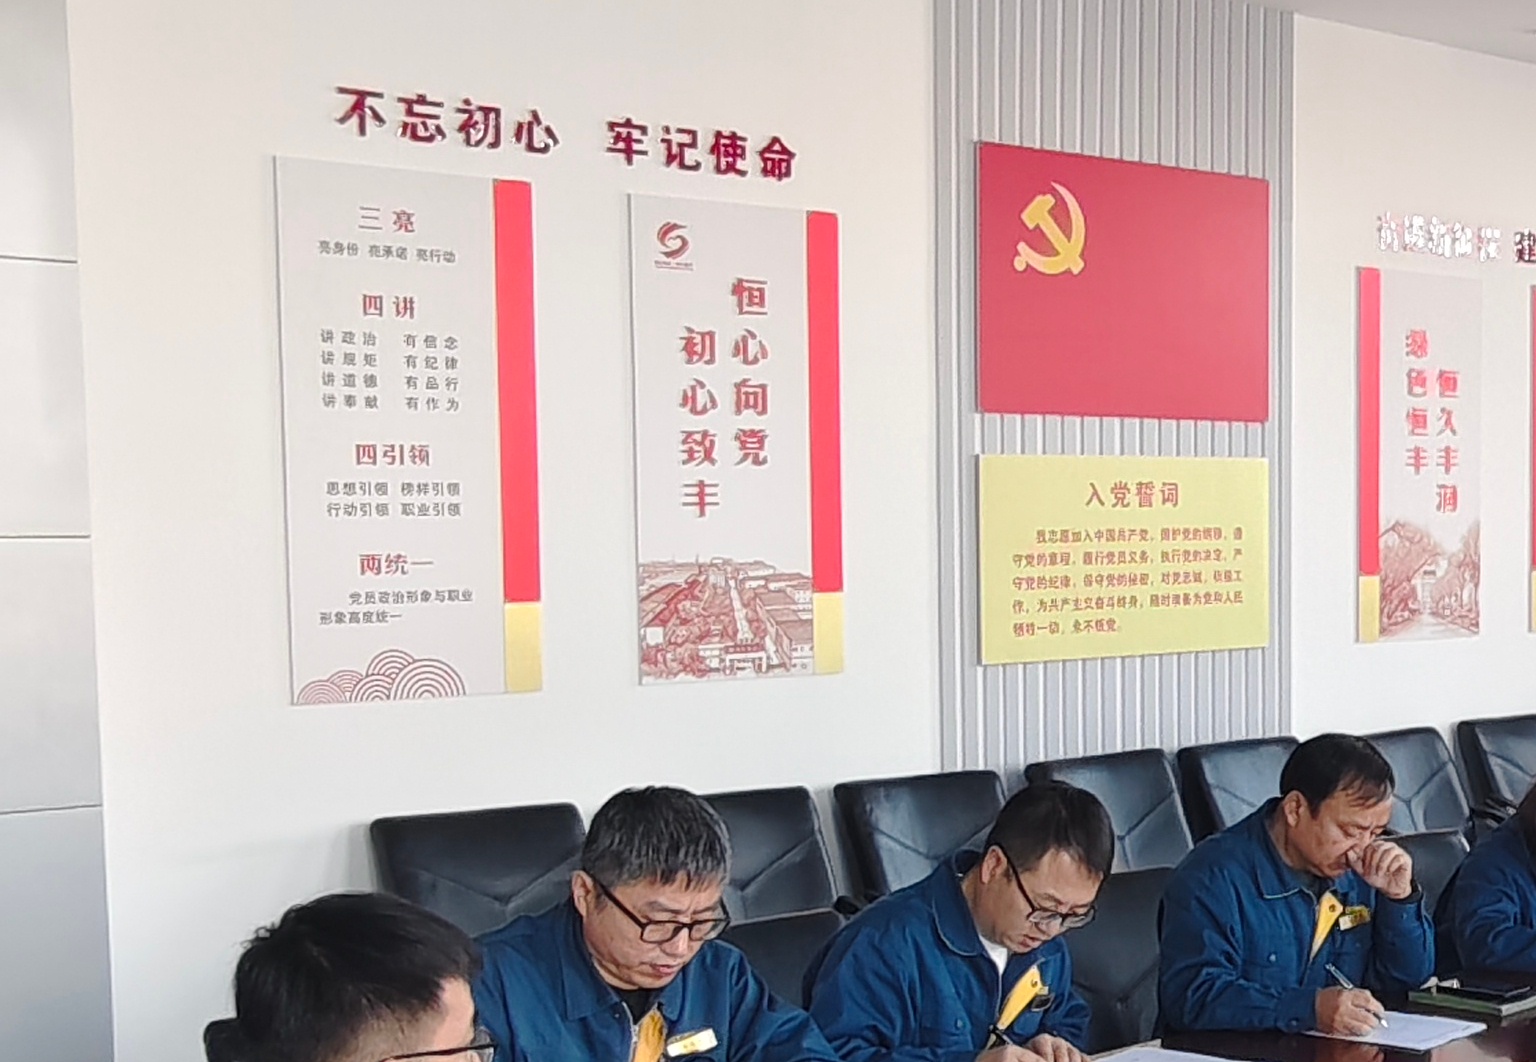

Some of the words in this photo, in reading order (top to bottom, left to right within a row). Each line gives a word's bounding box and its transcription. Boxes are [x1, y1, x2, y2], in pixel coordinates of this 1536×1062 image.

[335, 86, 561, 154] 不忘初心
[605, 117, 796, 181] 牢记使命
[358, 206, 416, 234] 三亮
[319, 240, 359, 256] 亮身份
[416, 249, 456, 263] 亮行动
[362, 294, 415, 319] 四讲
[320, 329, 377, 346] 讲政治
[403, 333, 459, 350] 有信念
[321, 350, 378, 367] 讲规矩
[404, 355, 459, 371] 有纪律
[322, 372, 379, 389] 讲道德
[404, 376, 459, 392] 有品行
[730, 276, 770, 468] 恒心向党
[322, 394, 380, 410] 讲奉献
[404, 397, 460, 412] 有作为
[678, 325, 720, 518] 初心致丰
[355, 444, 431, 466] 四引领
[326, 481, 389, 496] 思想引领
[401, 482, 461, 496] 榜样引领
[1085, 480, 1180, 508] 入党誓词
[327, 502, 390, 517] 行动引领
[401, 502, 462, 517] 职业引领
[359, 553, 434, 576] 两统一
[319, 610, 402, 626] 形象高度统一
